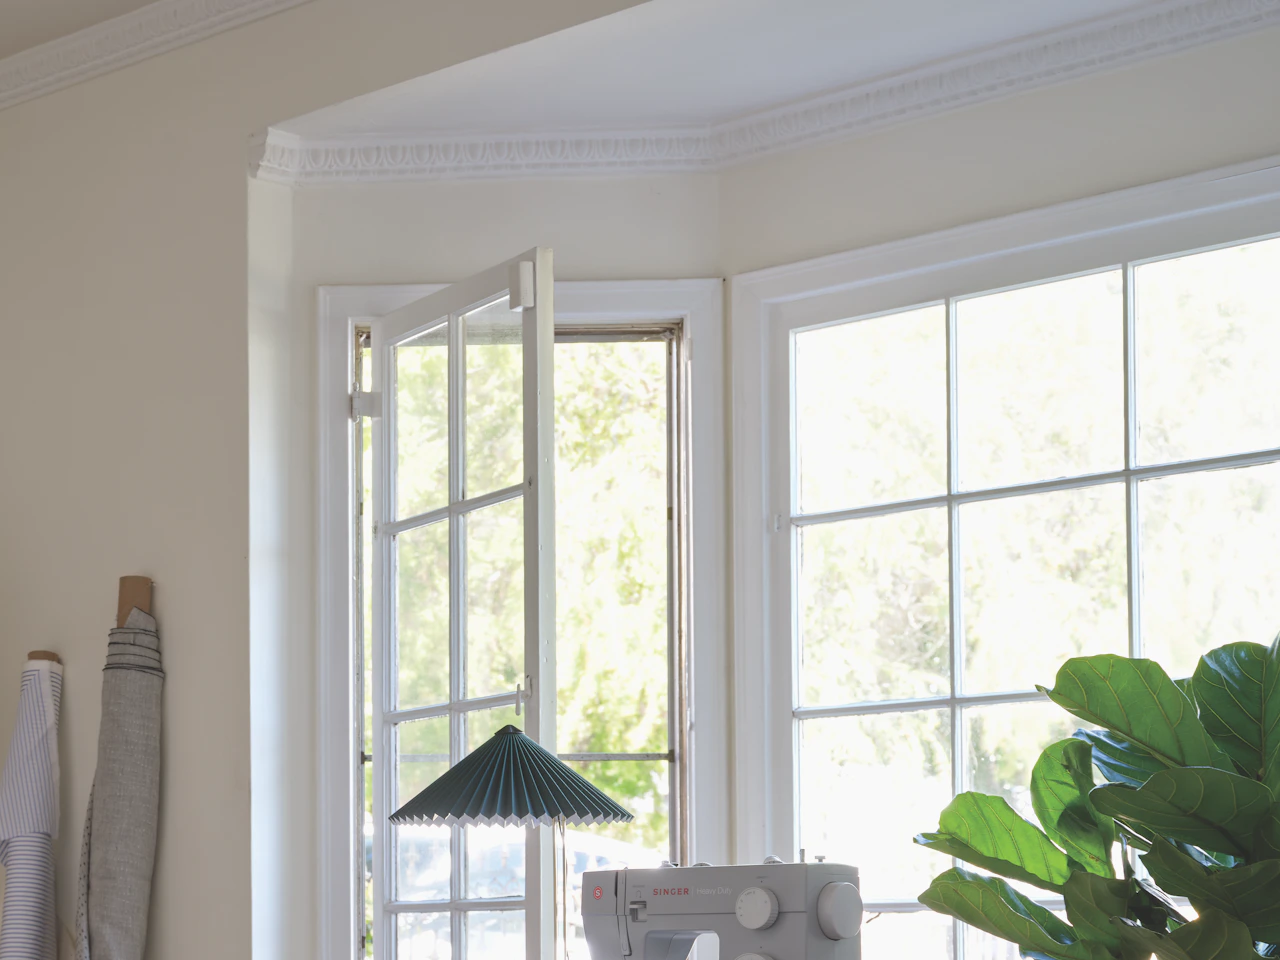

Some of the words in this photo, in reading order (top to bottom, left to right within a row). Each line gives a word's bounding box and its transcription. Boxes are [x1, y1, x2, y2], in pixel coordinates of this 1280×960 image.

[653, 888, 689, 896] SINGER
[697, 887, 716, 896] Heavy
[717, 886, 732, 896] Duty
